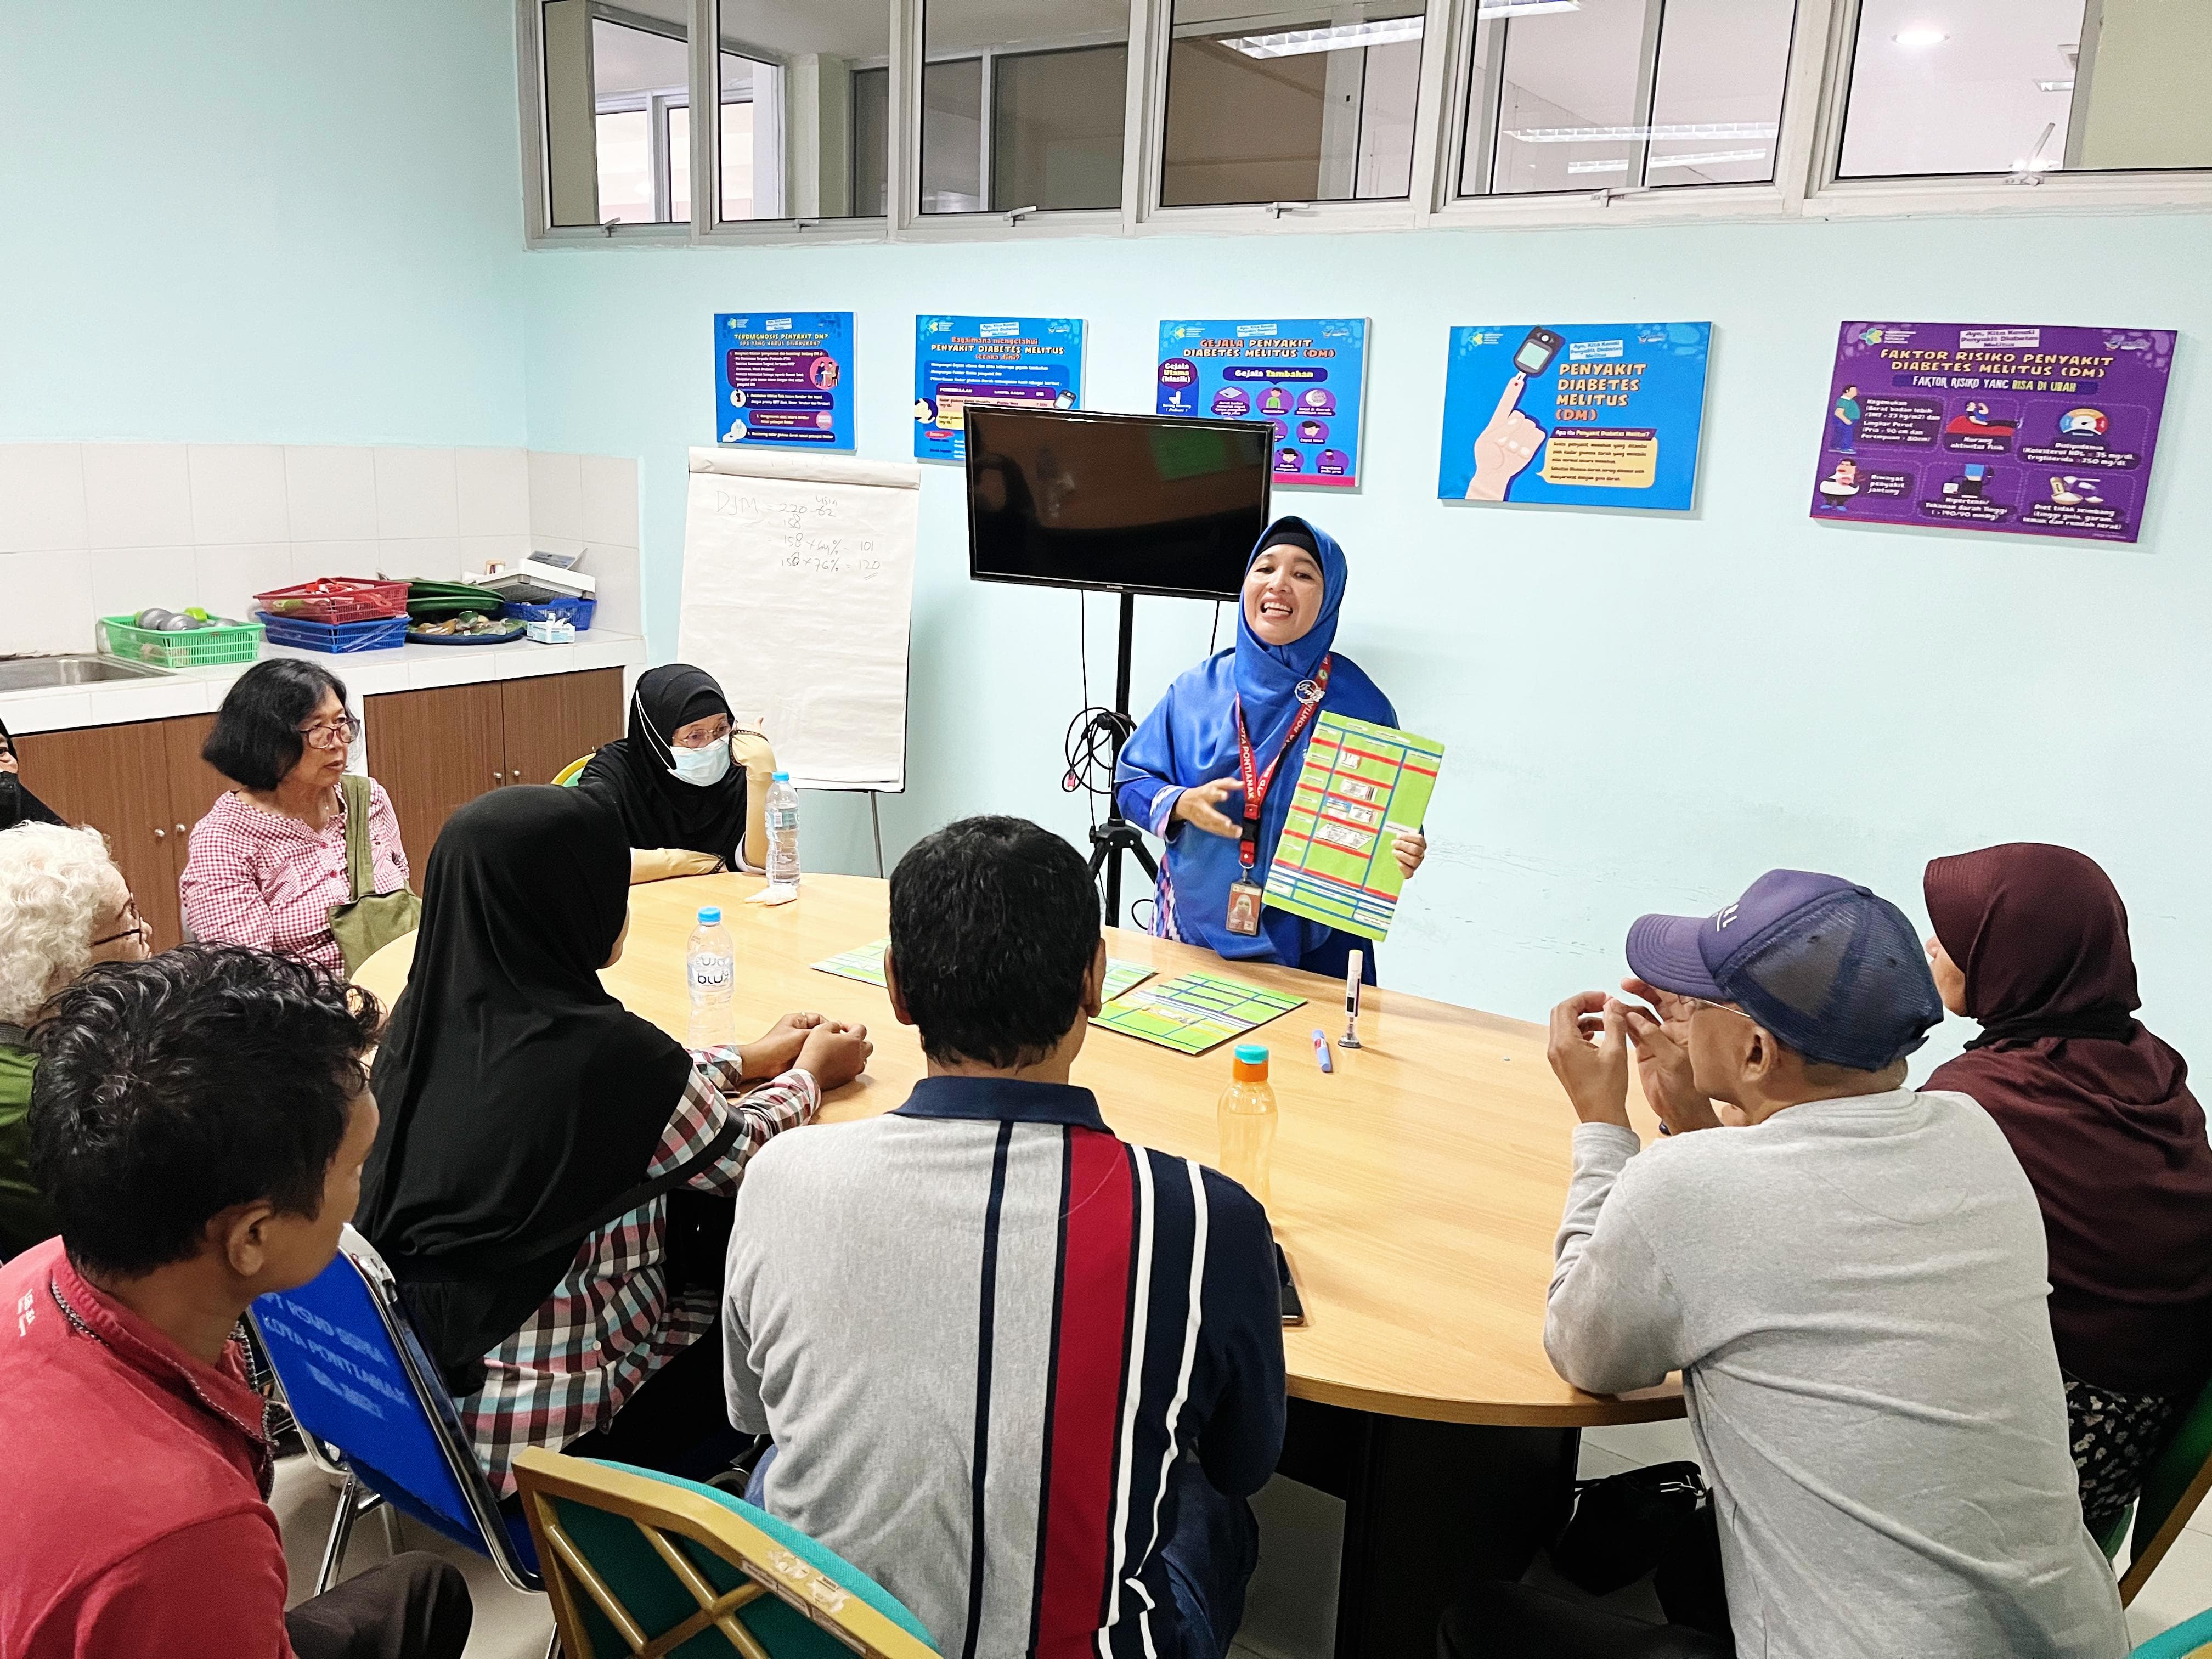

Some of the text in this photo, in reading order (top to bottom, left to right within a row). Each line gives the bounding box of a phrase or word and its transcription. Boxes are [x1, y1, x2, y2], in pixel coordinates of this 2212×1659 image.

[978, 345, 1021, 353] DIABETES
[1200, 339, 1312, 347] GEJALA PENYAKIT
[1183, 349, 1335, 357] DIABETES MELITUS (DM)
[1880, 349, 2114, 366] FAKTOR RISIKO PENYAKIT
[1234, 370, 1313, 379] Gejala Tambahan
[1559, 363, 1647, 376] PENYAKIT
[1891, 361, 2105, 378] DIABETES MELITUS (DM)
[1558, 379, 1640, 391] DIABETES
[1912, 376, 2077, 392] FAKTOR RISIKO YANG BISA DI UBAH
[1556, 393, 1629, 407] MELITUS
[1555, 409, 1597, 421] (DM)
[778, 503, 808, 514] 220
[784, 513, 801, 529] 158
[785, 533, 803, 548] 158
[861, 540, 873, 551] 101
[815, 558, 839, 572] 76%
[859, 560, 880, 570] 120
[1242, 746, 1254, 799] PONTIANAK
